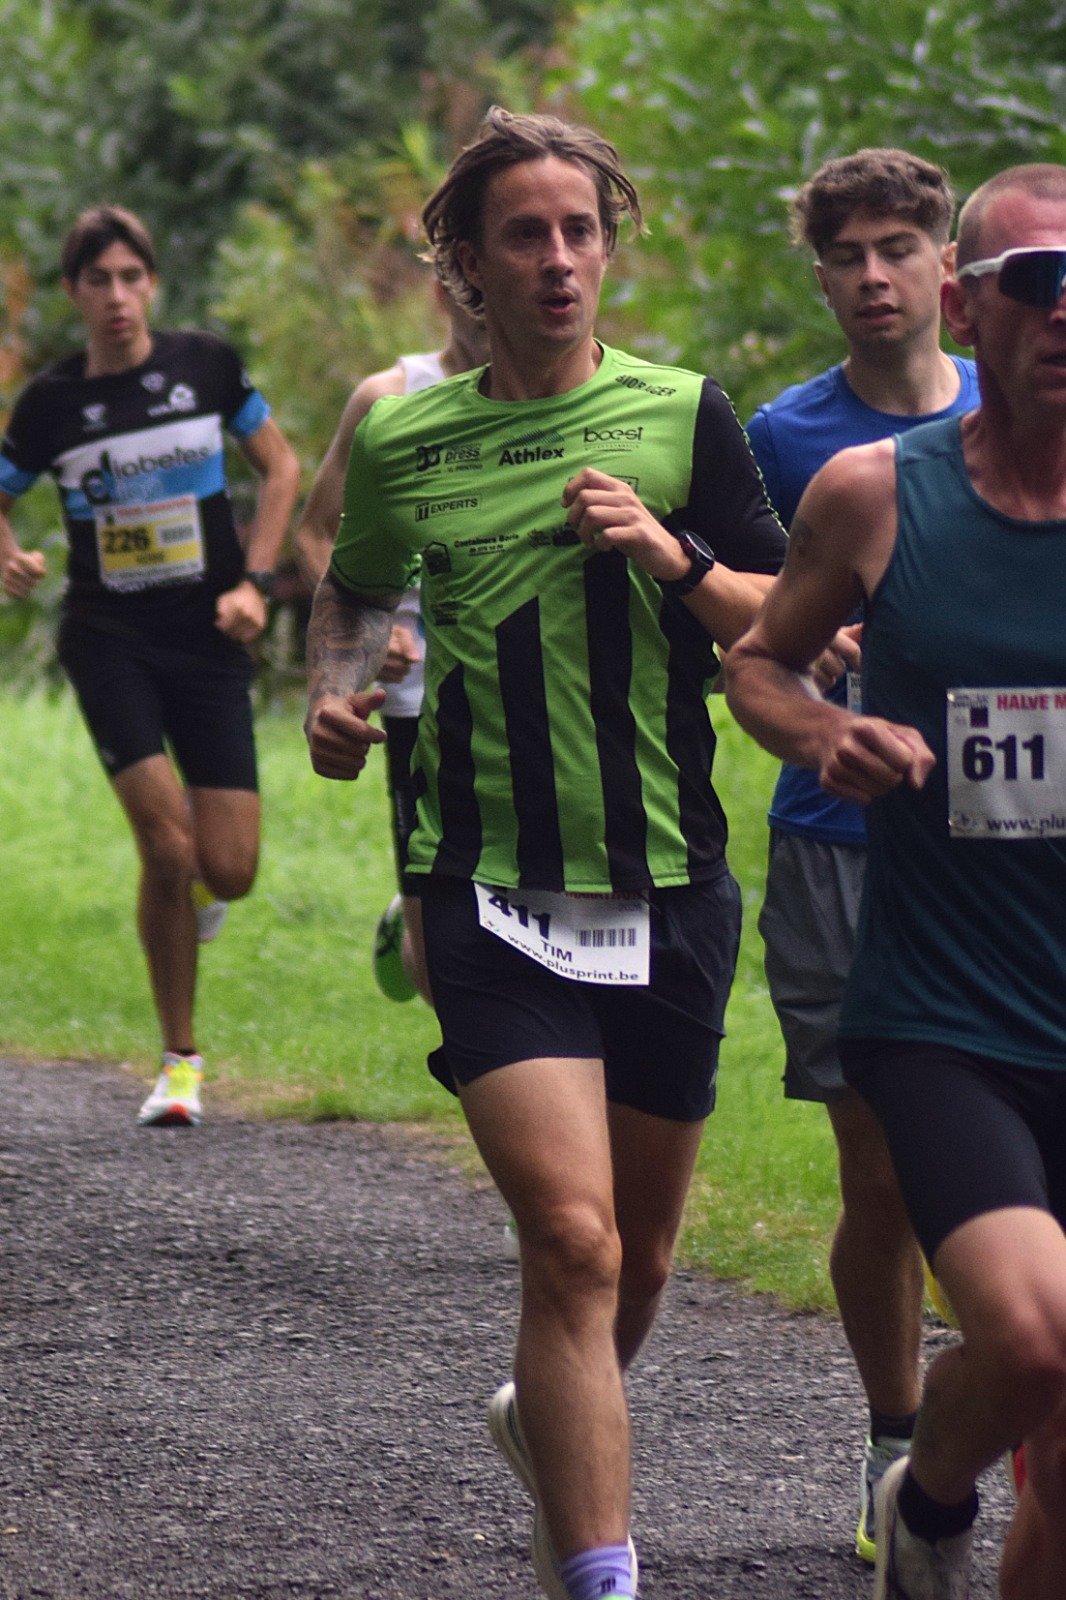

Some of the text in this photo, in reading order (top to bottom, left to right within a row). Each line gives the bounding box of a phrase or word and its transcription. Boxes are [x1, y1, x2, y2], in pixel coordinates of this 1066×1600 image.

[498, 446, 565, 466] Athlex
[431, 498, 478, 514] EXPERTS
[997, 694, 1048, 710] HALVE
[962, 733, 1044, 782] 611
[487, 891, 551, 939] 411
[507, 934, 639, 980] www.plusprint.be
[541, 940, 573, 962] TIM
